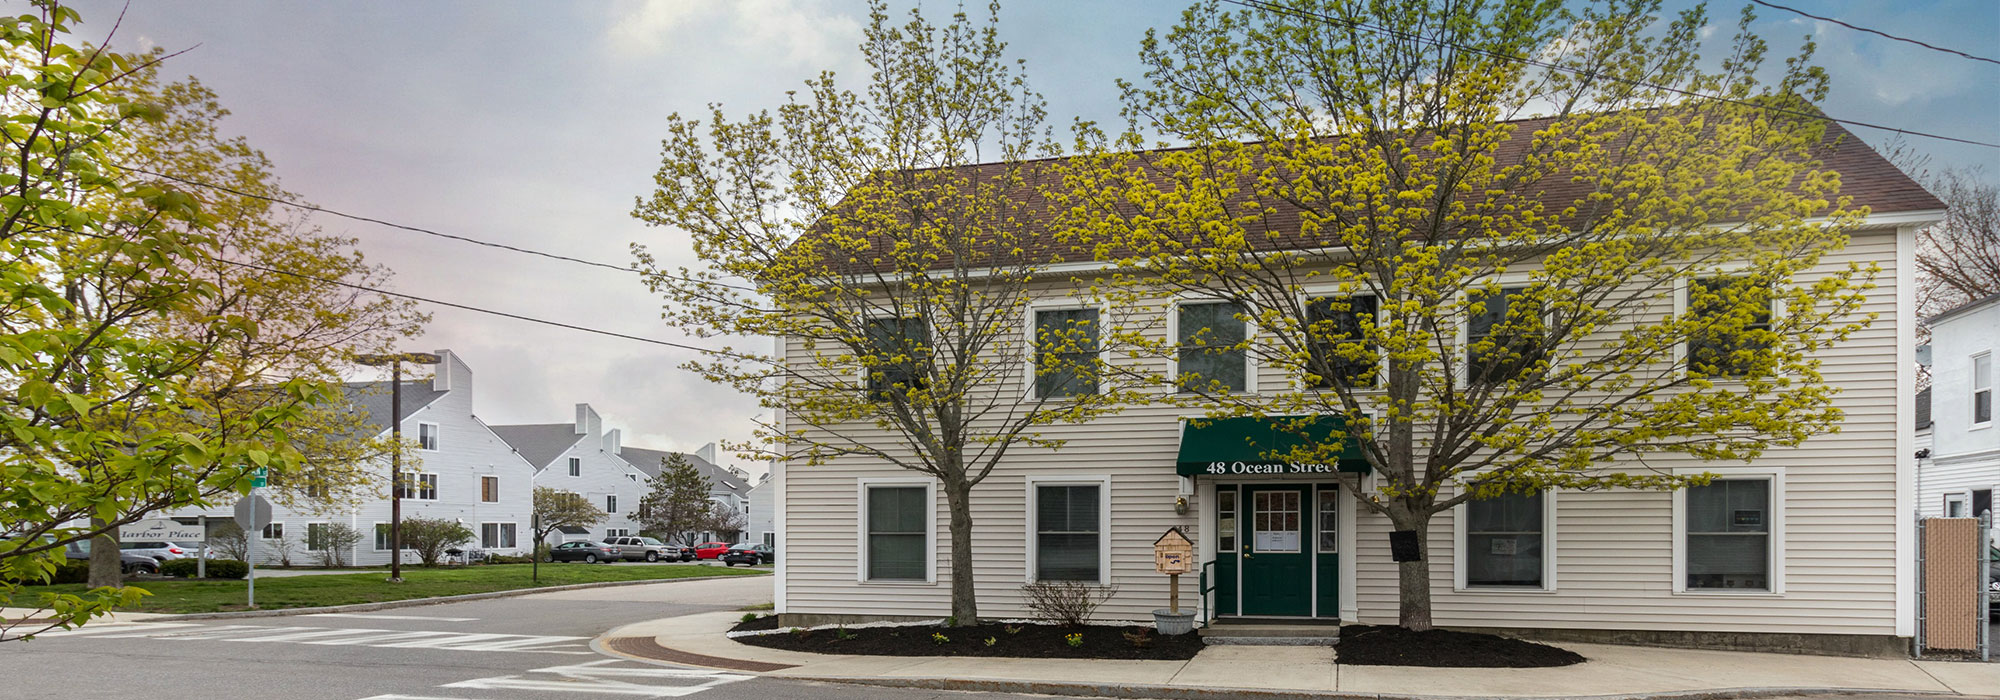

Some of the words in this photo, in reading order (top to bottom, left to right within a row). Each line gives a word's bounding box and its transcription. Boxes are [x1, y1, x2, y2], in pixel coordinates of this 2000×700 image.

[1206, 461, 1226, 474] 48
[1231, 461, 1284, 474] Ocean
[168, 530, 201, 538] Place
